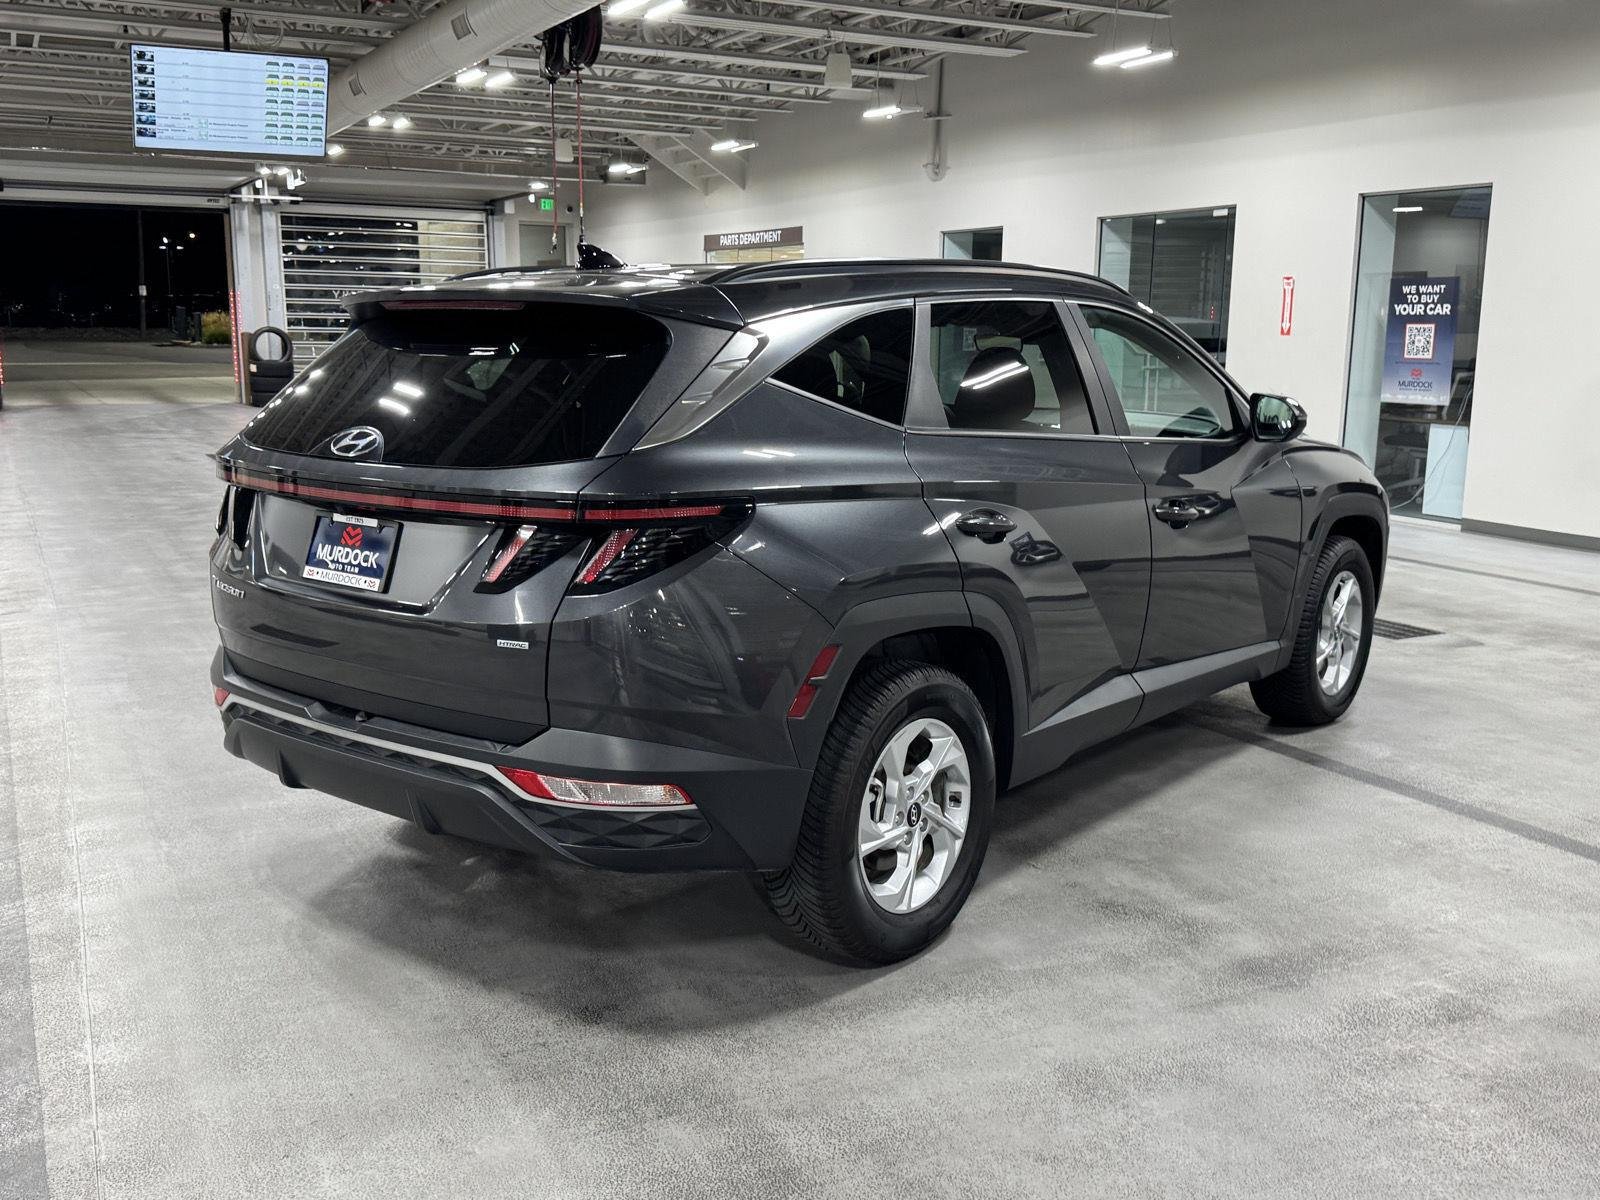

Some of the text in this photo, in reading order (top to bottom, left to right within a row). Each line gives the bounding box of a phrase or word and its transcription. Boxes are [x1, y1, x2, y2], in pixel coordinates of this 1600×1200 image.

[720, 231, 781, 246] PARTS DEPARTMENT
[1402, 285, 1446, 294] WE WANT
[1407, 295, 1440, 303] TO BUY
[1394, 303, 1451, 315] YOUR CAR
[1398, 380, 1433, 389] MURDOCK
[316, 543, 380, 569] MURDOCK
[344, 564, 359, 573] TEAM
[320, 571, 362, 586] MURDOCK
